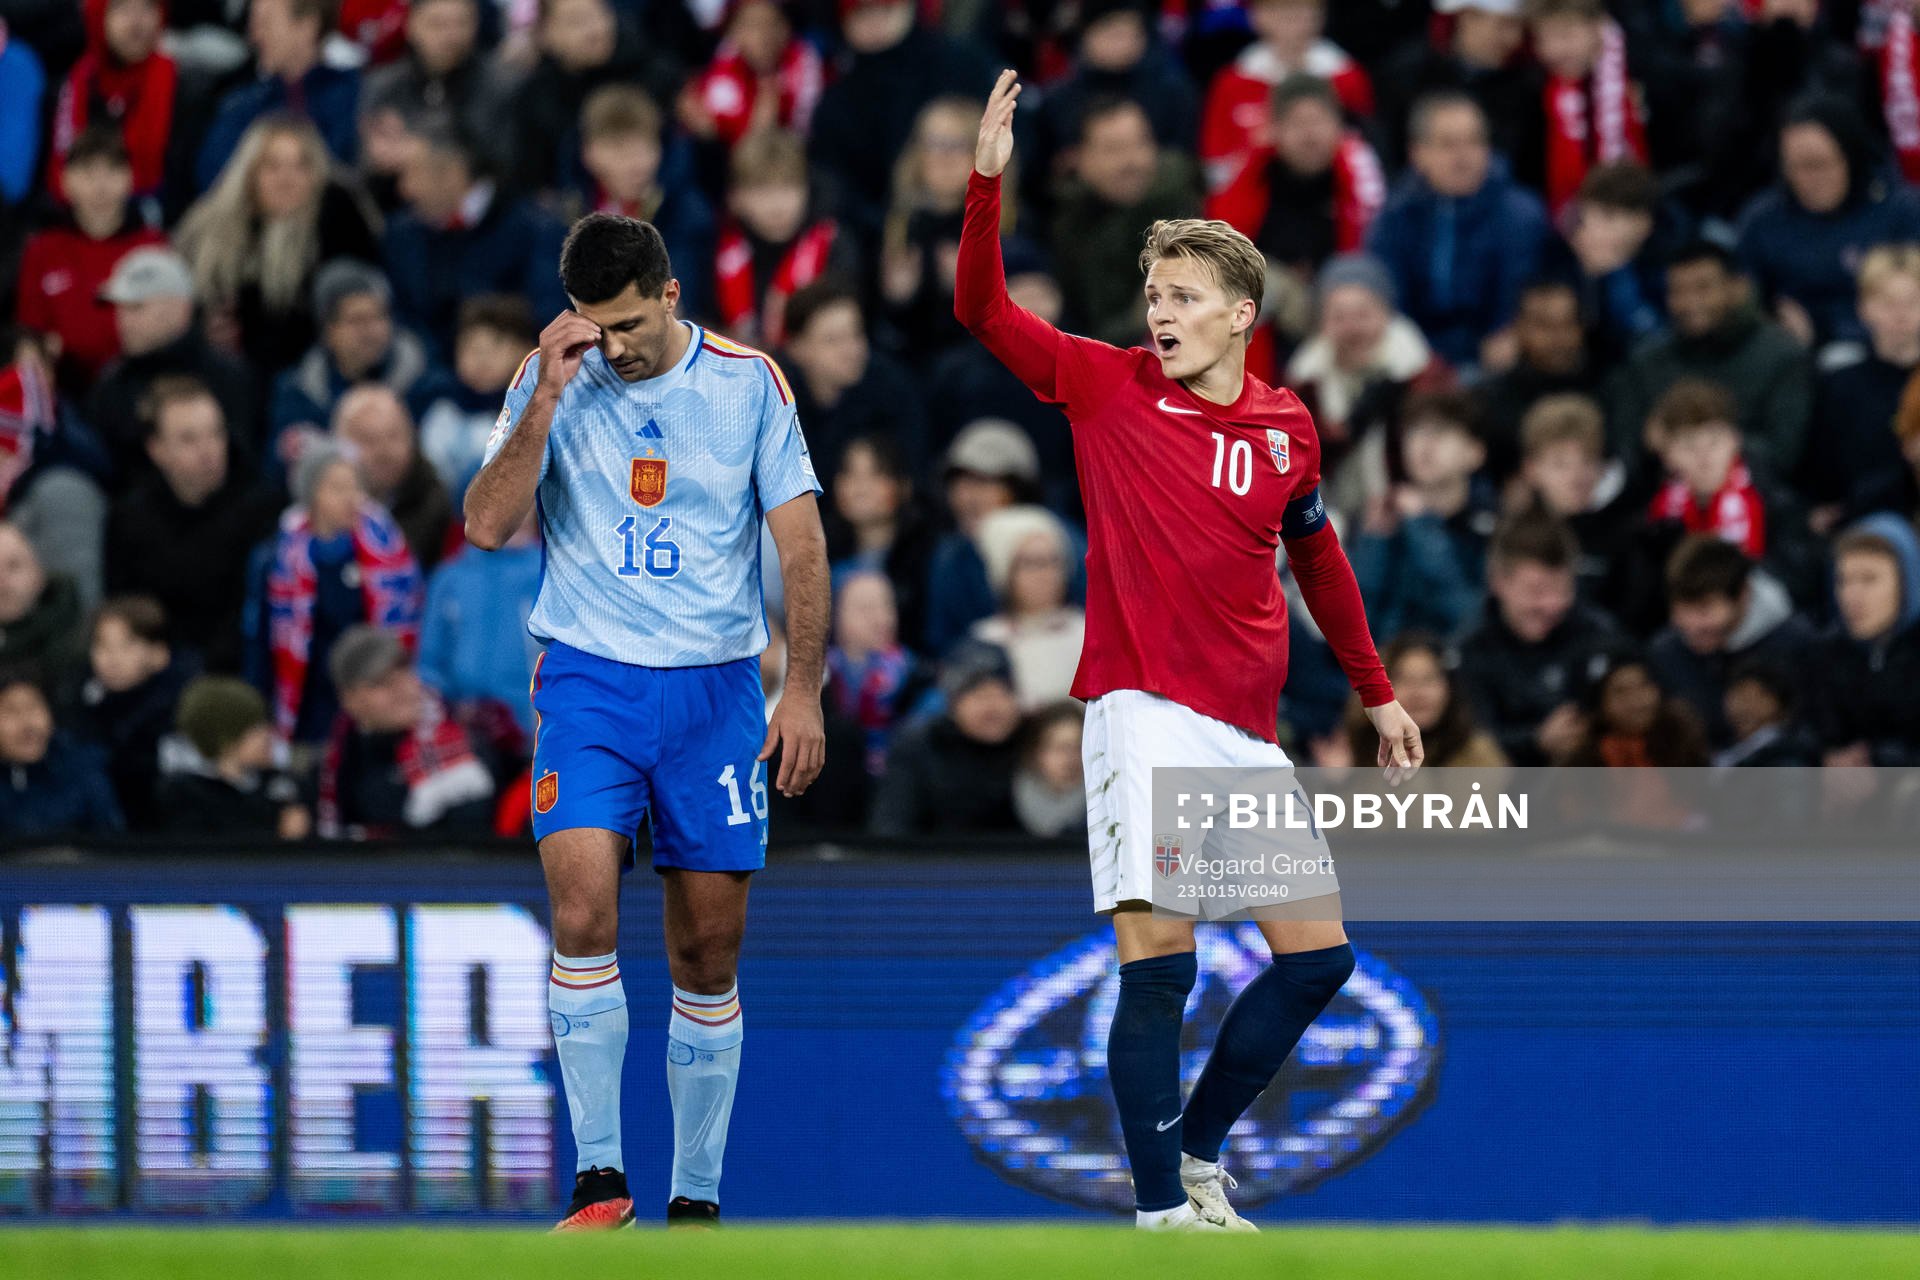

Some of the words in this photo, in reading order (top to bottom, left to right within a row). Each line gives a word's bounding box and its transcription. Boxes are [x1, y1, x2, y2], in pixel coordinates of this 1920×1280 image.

[1211, 431, 1253, 497] 10
[613, 514, 682, 579] 16
[717, 758, 768, 826] 16
